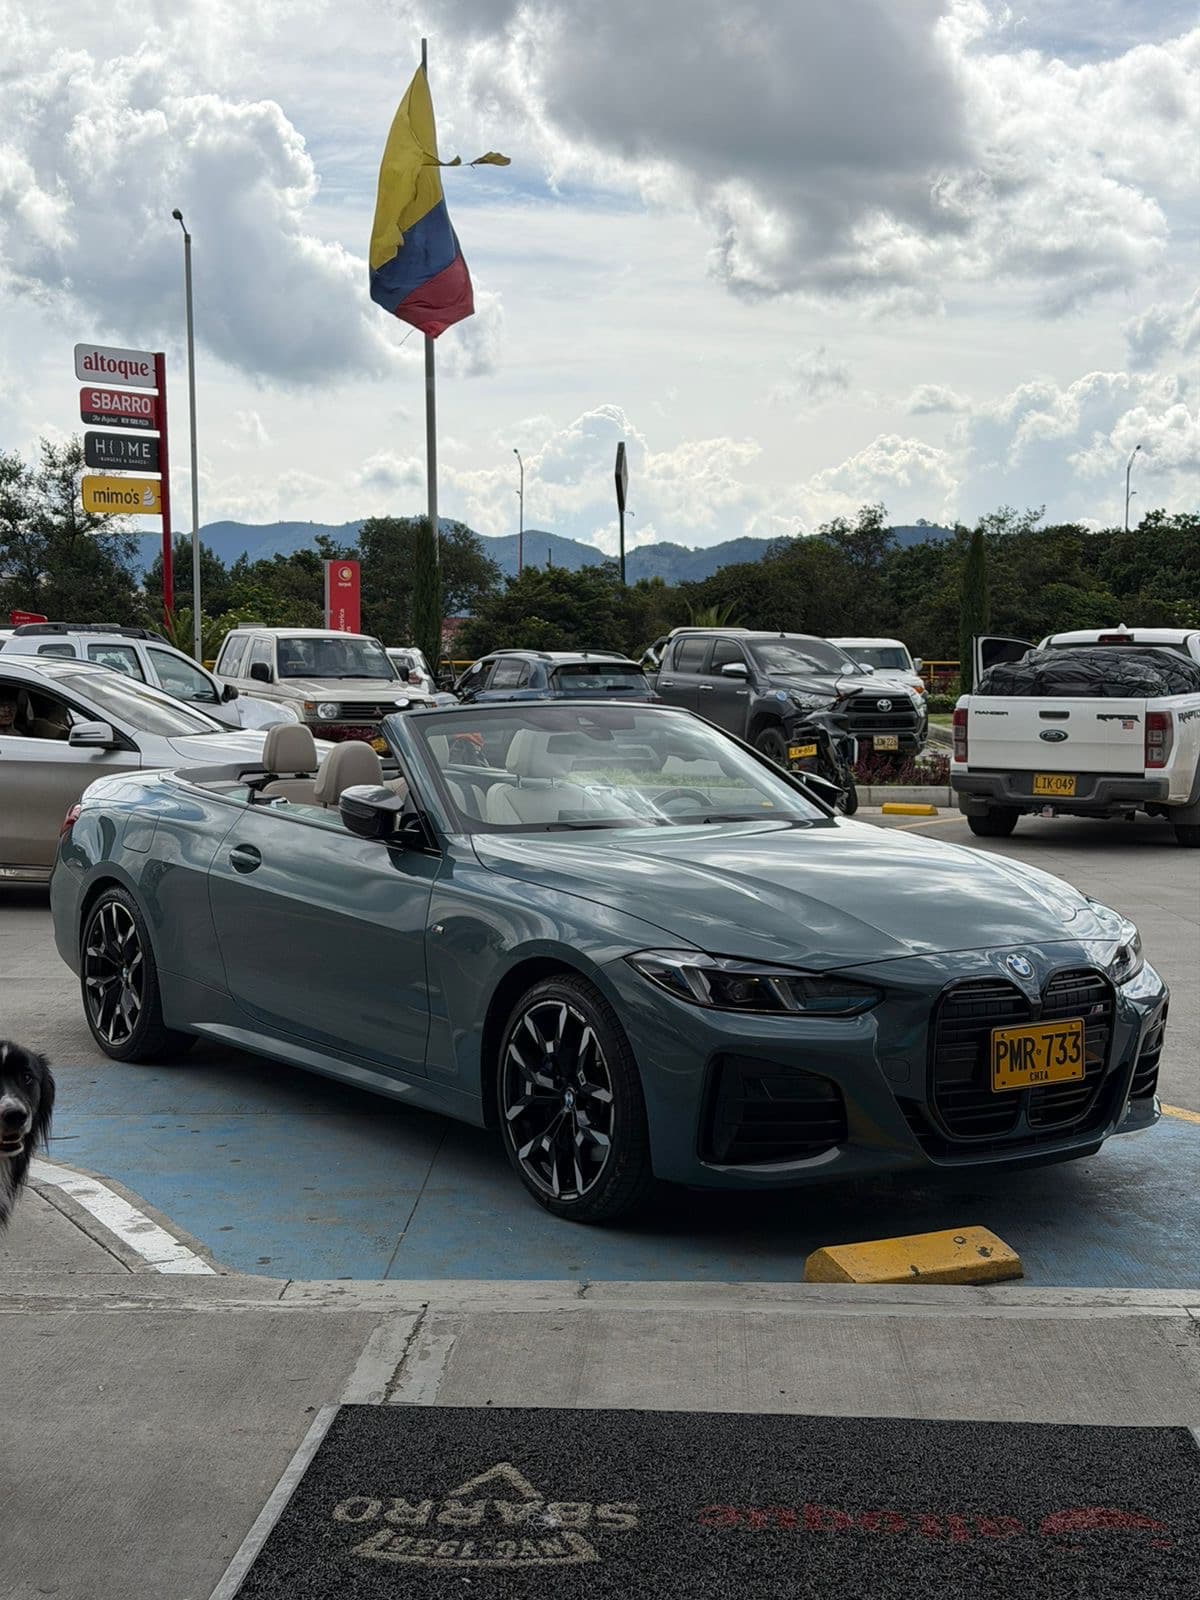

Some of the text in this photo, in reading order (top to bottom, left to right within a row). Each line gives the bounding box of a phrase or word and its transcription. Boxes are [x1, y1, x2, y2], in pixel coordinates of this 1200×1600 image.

[83, 351, 149, 380] altoque
[91, 392, 151, 414] SBARRO
[93, 488, 140, 505] mimo's
[1096, 713, 1141, 723] RAPTOR
[1029, 1070, 1049, 1082] CHIA
